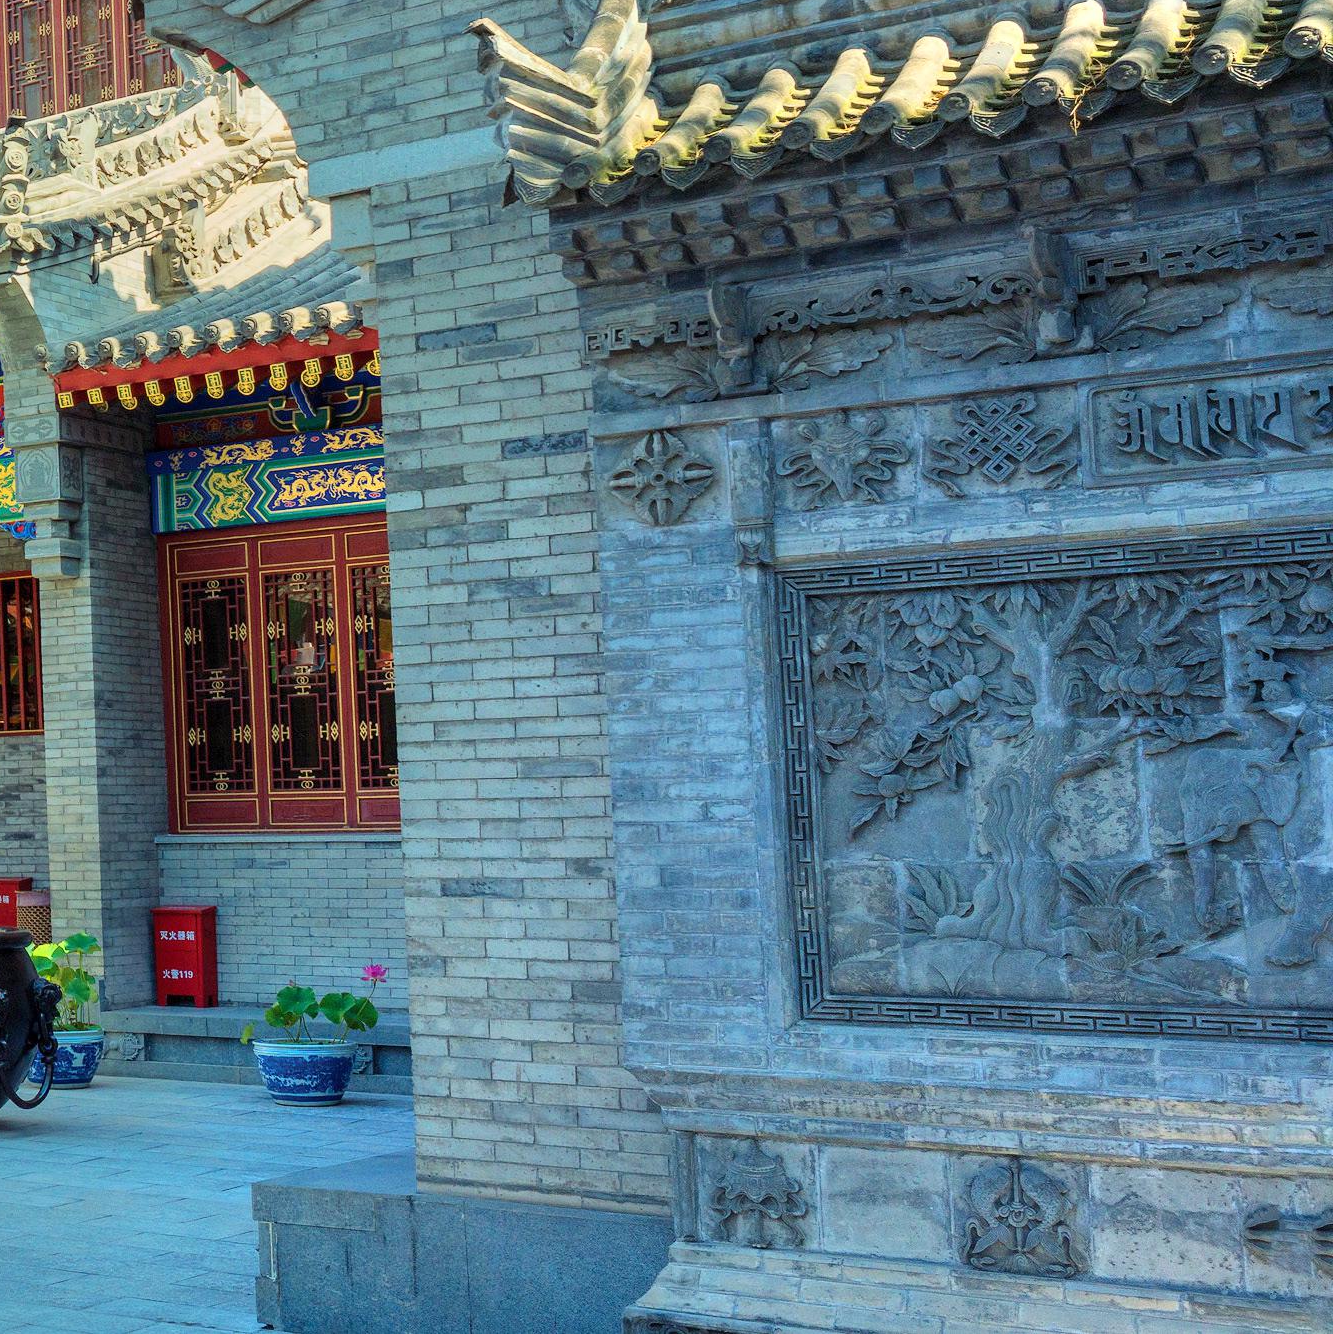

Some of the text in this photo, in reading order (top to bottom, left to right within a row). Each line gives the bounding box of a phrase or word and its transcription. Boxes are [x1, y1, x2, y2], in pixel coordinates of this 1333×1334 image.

[159, 930, 195, 941] 灭火器箱
[162, 969, 193, 979] 火警119
